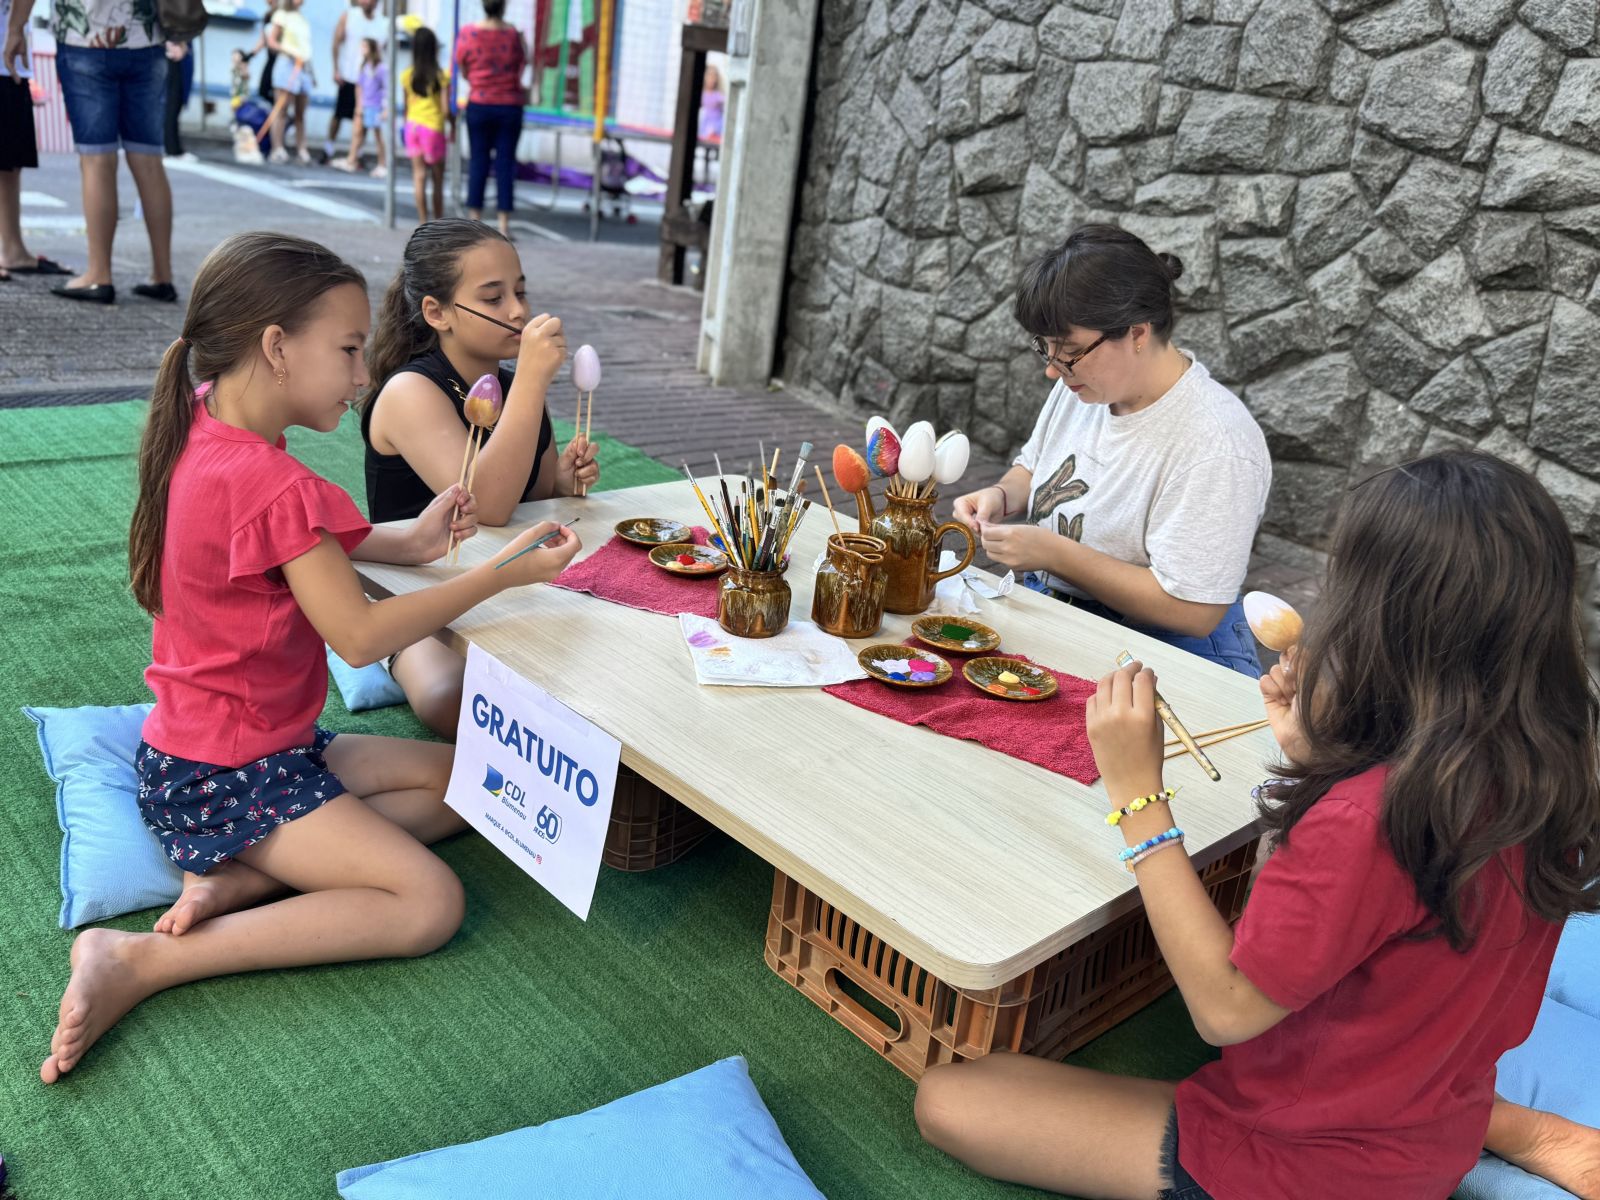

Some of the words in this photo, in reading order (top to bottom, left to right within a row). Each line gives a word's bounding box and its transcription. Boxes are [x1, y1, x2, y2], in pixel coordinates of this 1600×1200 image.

[472, 693, 599, 807] GRATUITO
[501, 796, 527, 820] Blumenau
[505, 780, 526, 808] CDL
[485, 812, 501, 830] MARQUE
[537, 804, 558, 840] 60
